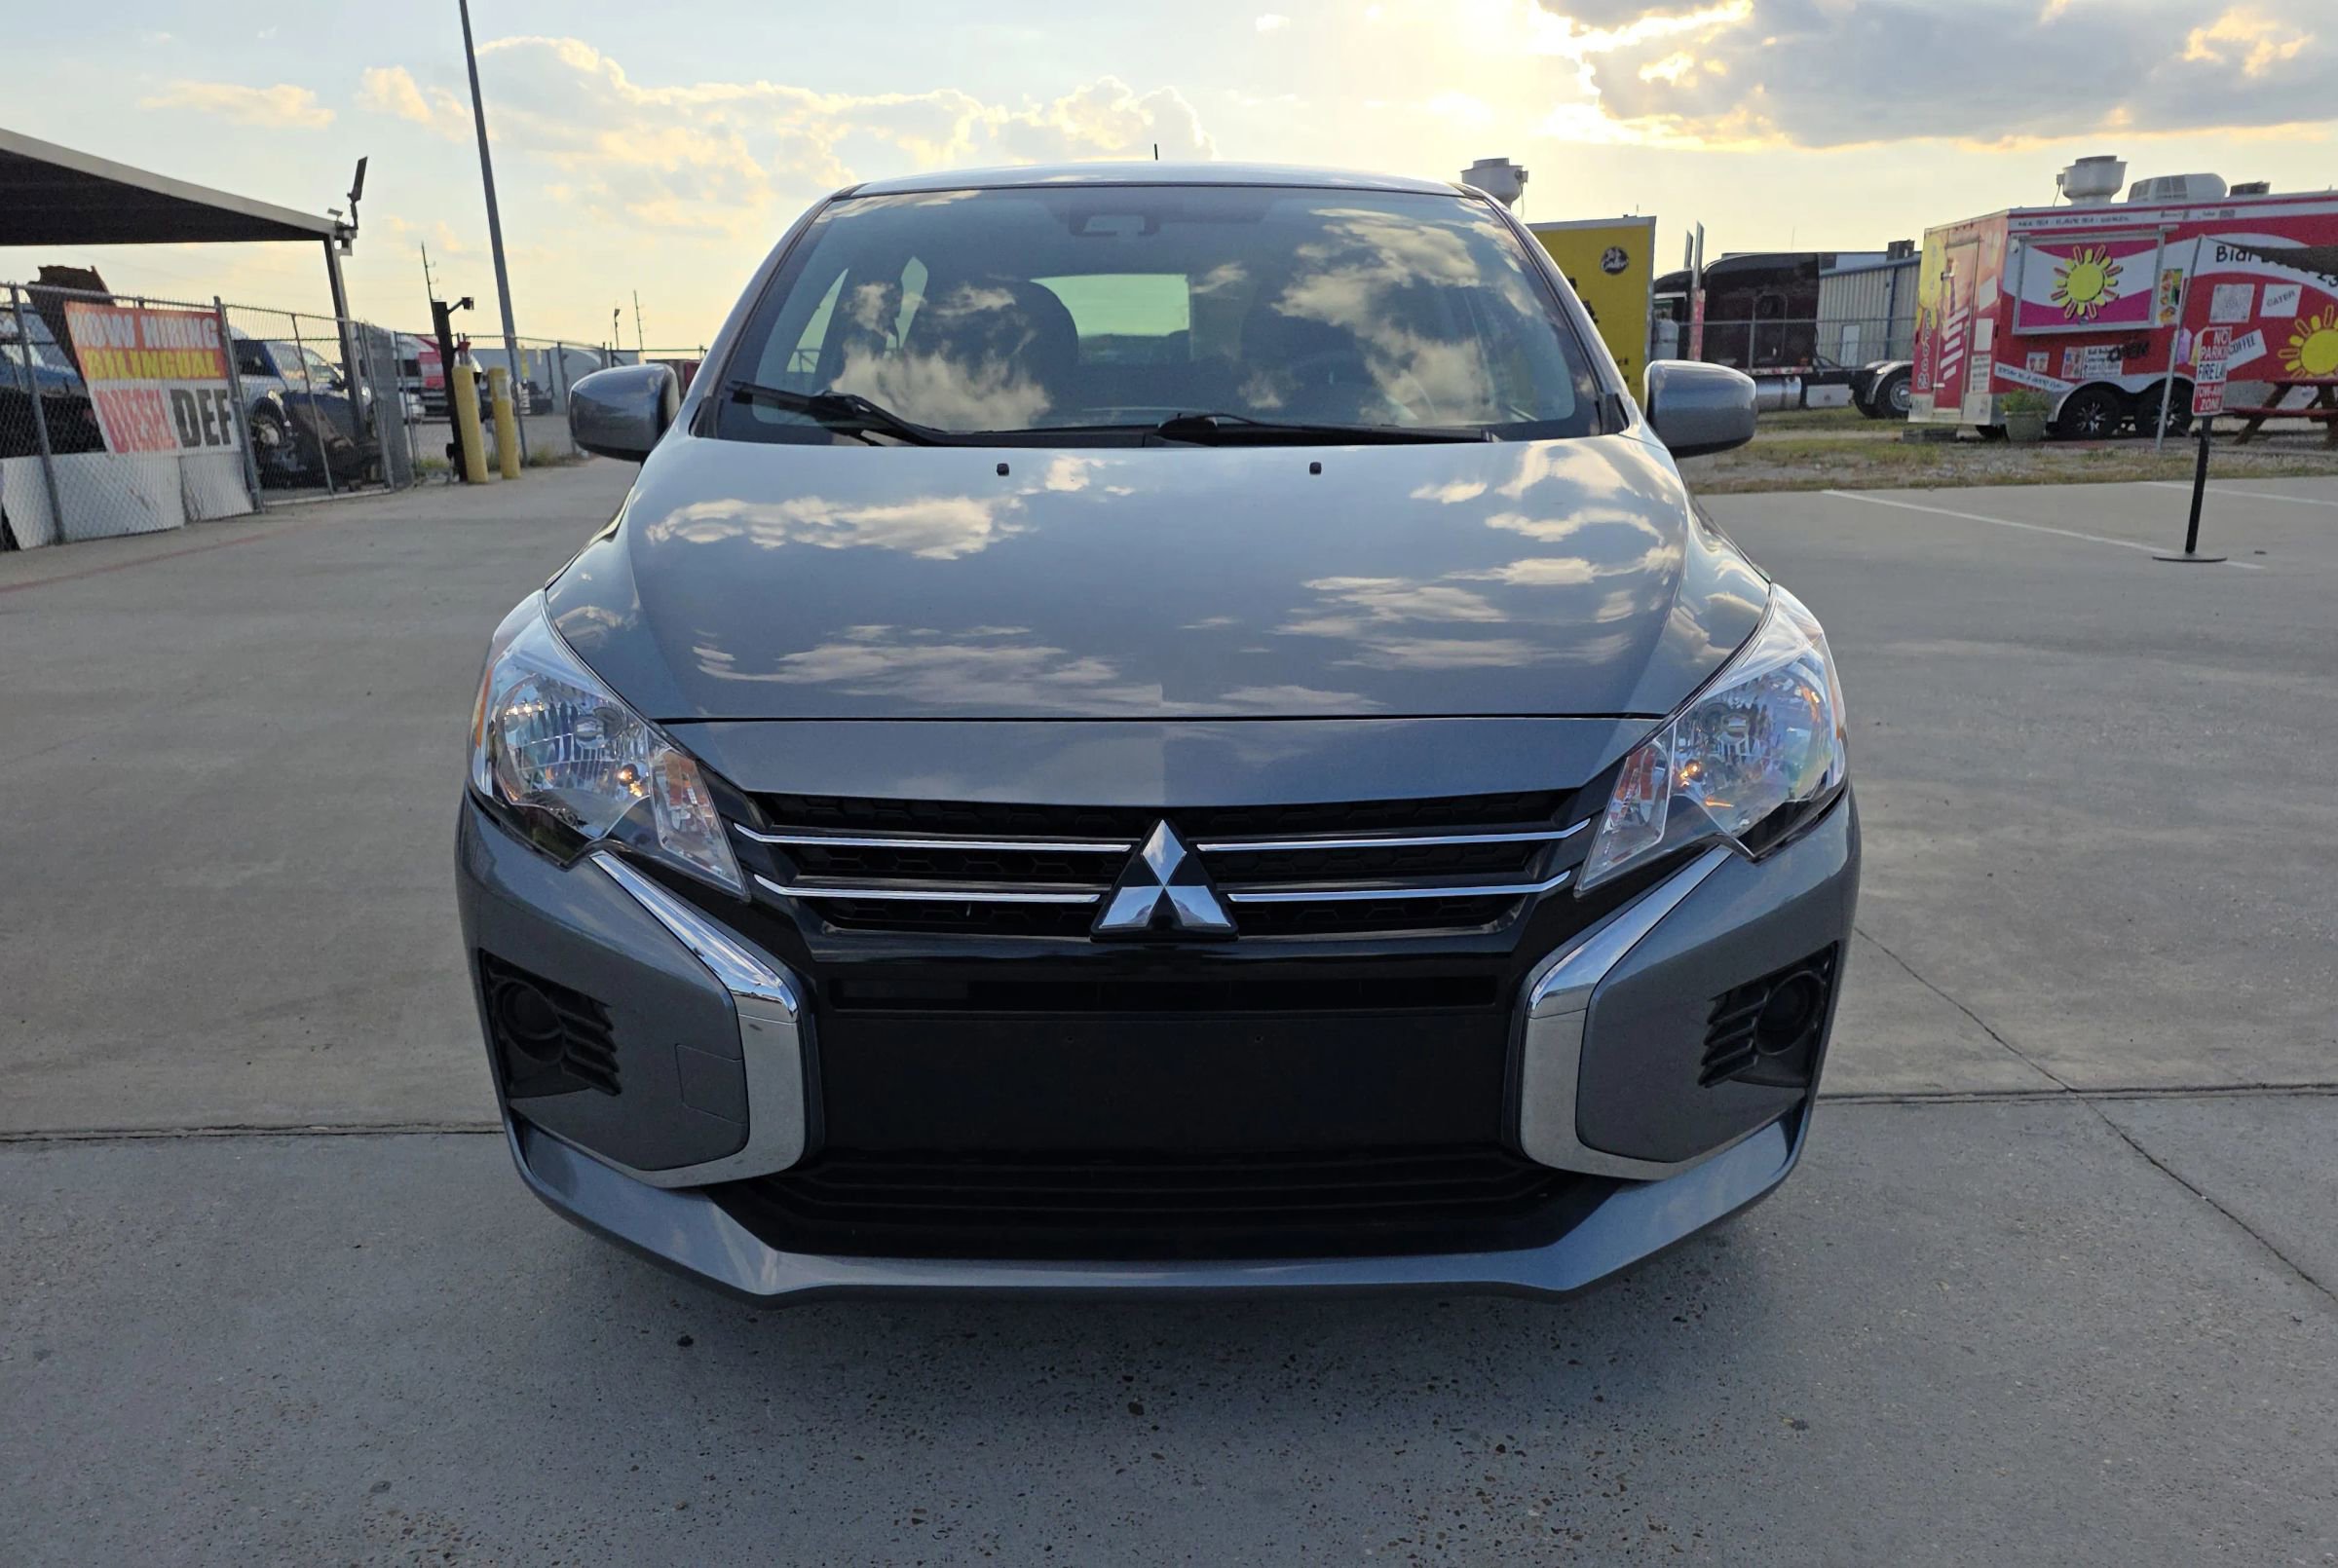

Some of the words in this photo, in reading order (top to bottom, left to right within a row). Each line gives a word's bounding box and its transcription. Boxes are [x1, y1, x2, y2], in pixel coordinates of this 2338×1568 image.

[69, 312, 136, 349] NOW
[140, 317, 220, 350] HIRING
[2228, 333, 2255, 355] COFFEE
[83, 350, 222, 380] BILINGUAL
[2198, 363, 2215, 380] FIRE
[94, 389, 178, 455] DIESEL
[169, 389, 232, 448] DEF
